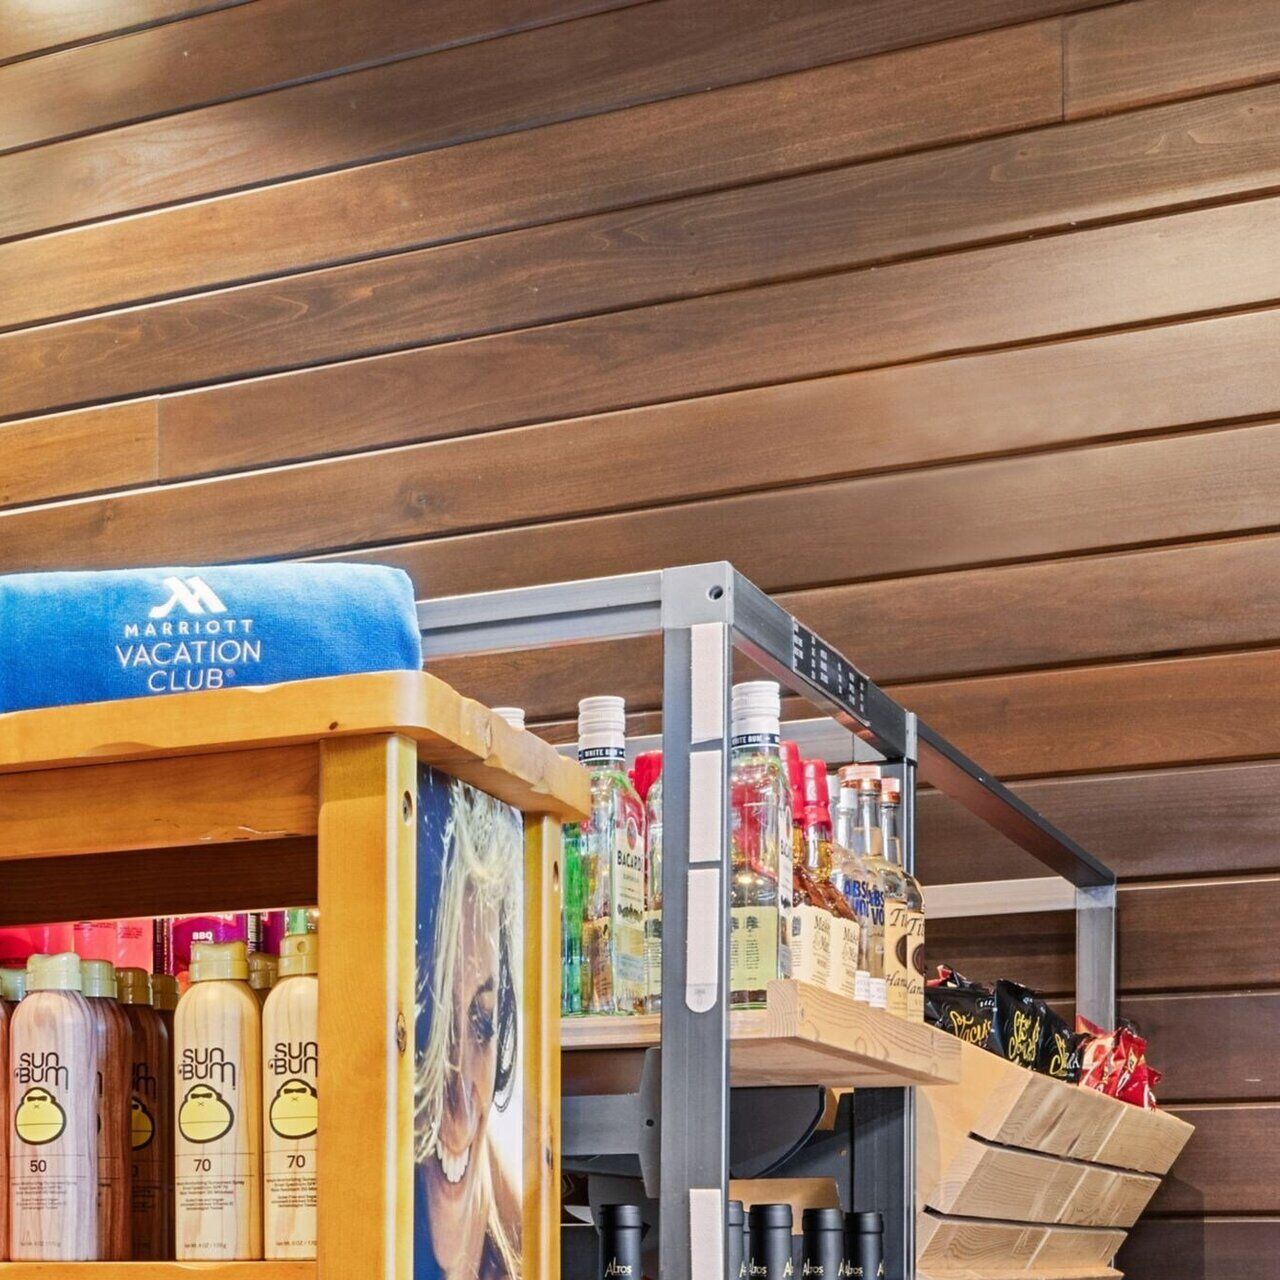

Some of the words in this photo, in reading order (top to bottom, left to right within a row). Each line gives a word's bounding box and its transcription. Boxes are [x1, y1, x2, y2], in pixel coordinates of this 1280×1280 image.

[124, 619, 254, 637] MARRIOTT
[116, 640, 261, 667] VACATION
[192, 930, 213, 941] BBQ
[30, 1159, 47, 1173] 50
[194, 1159, 212, 1173] 70
[287, 1154, 306, 1169] 70
